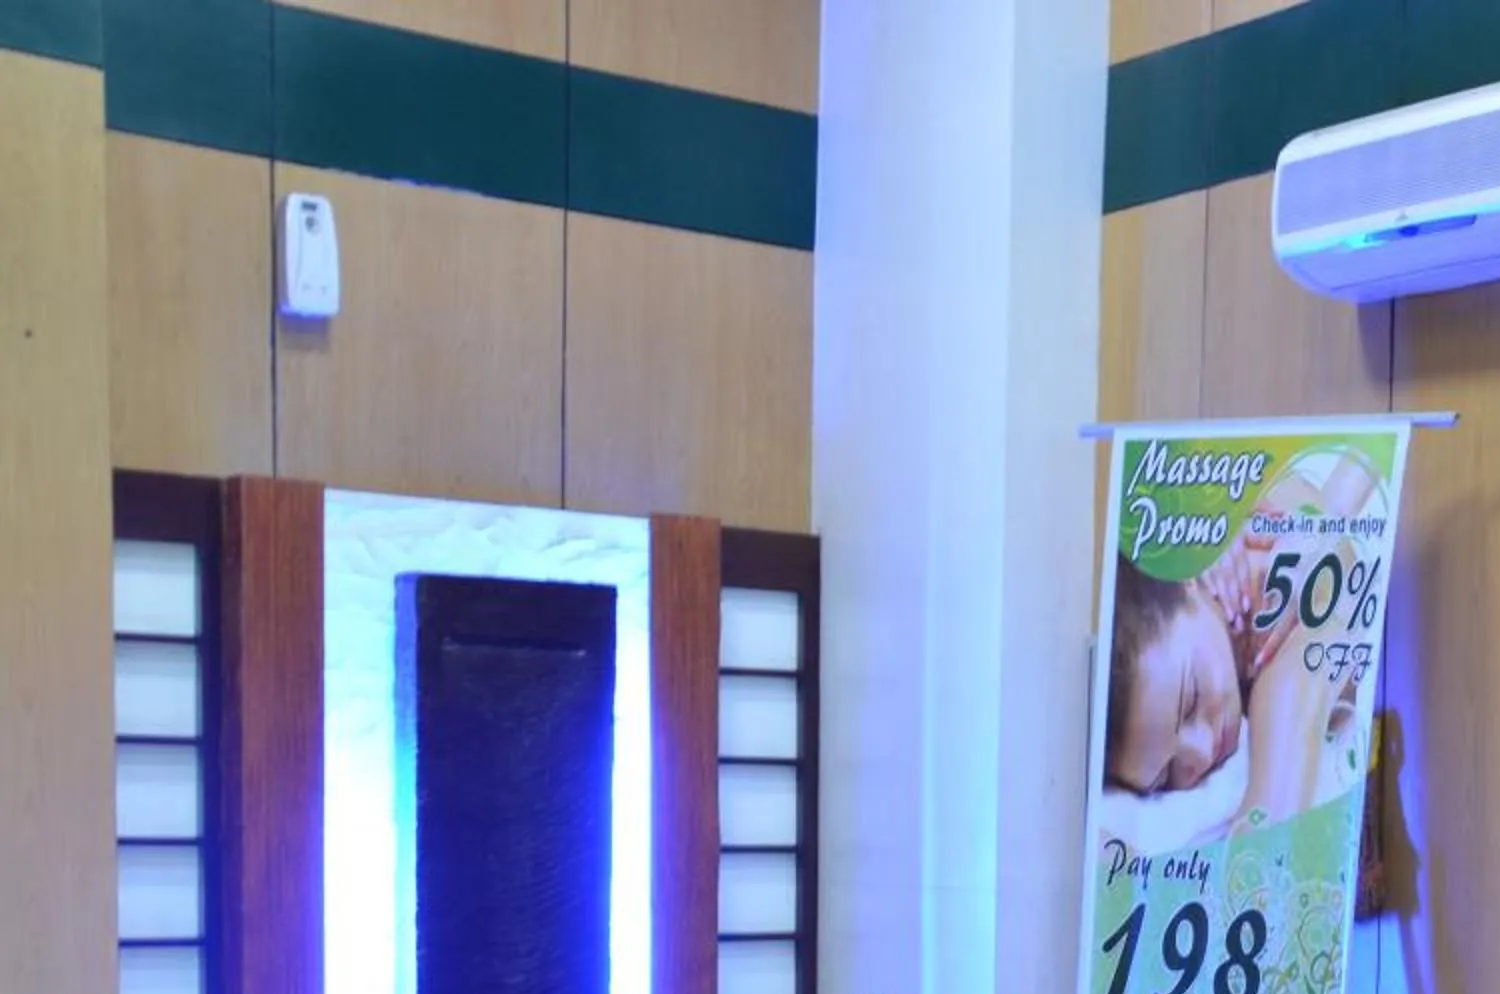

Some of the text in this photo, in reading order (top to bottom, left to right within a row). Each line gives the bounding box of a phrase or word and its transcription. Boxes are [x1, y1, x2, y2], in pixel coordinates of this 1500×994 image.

[1127, 439, 1266, 499] Massage
[1129, 497, 1229, 561] Promo
[1319, 517, 1346, 534] and
[1349, 514, 1388, 540] enjoy
[1252, 551, 1382, 631] 50%
[1303, 642, 1374, 682] OFF
[1103, 838, 1211, 895] Pay only
